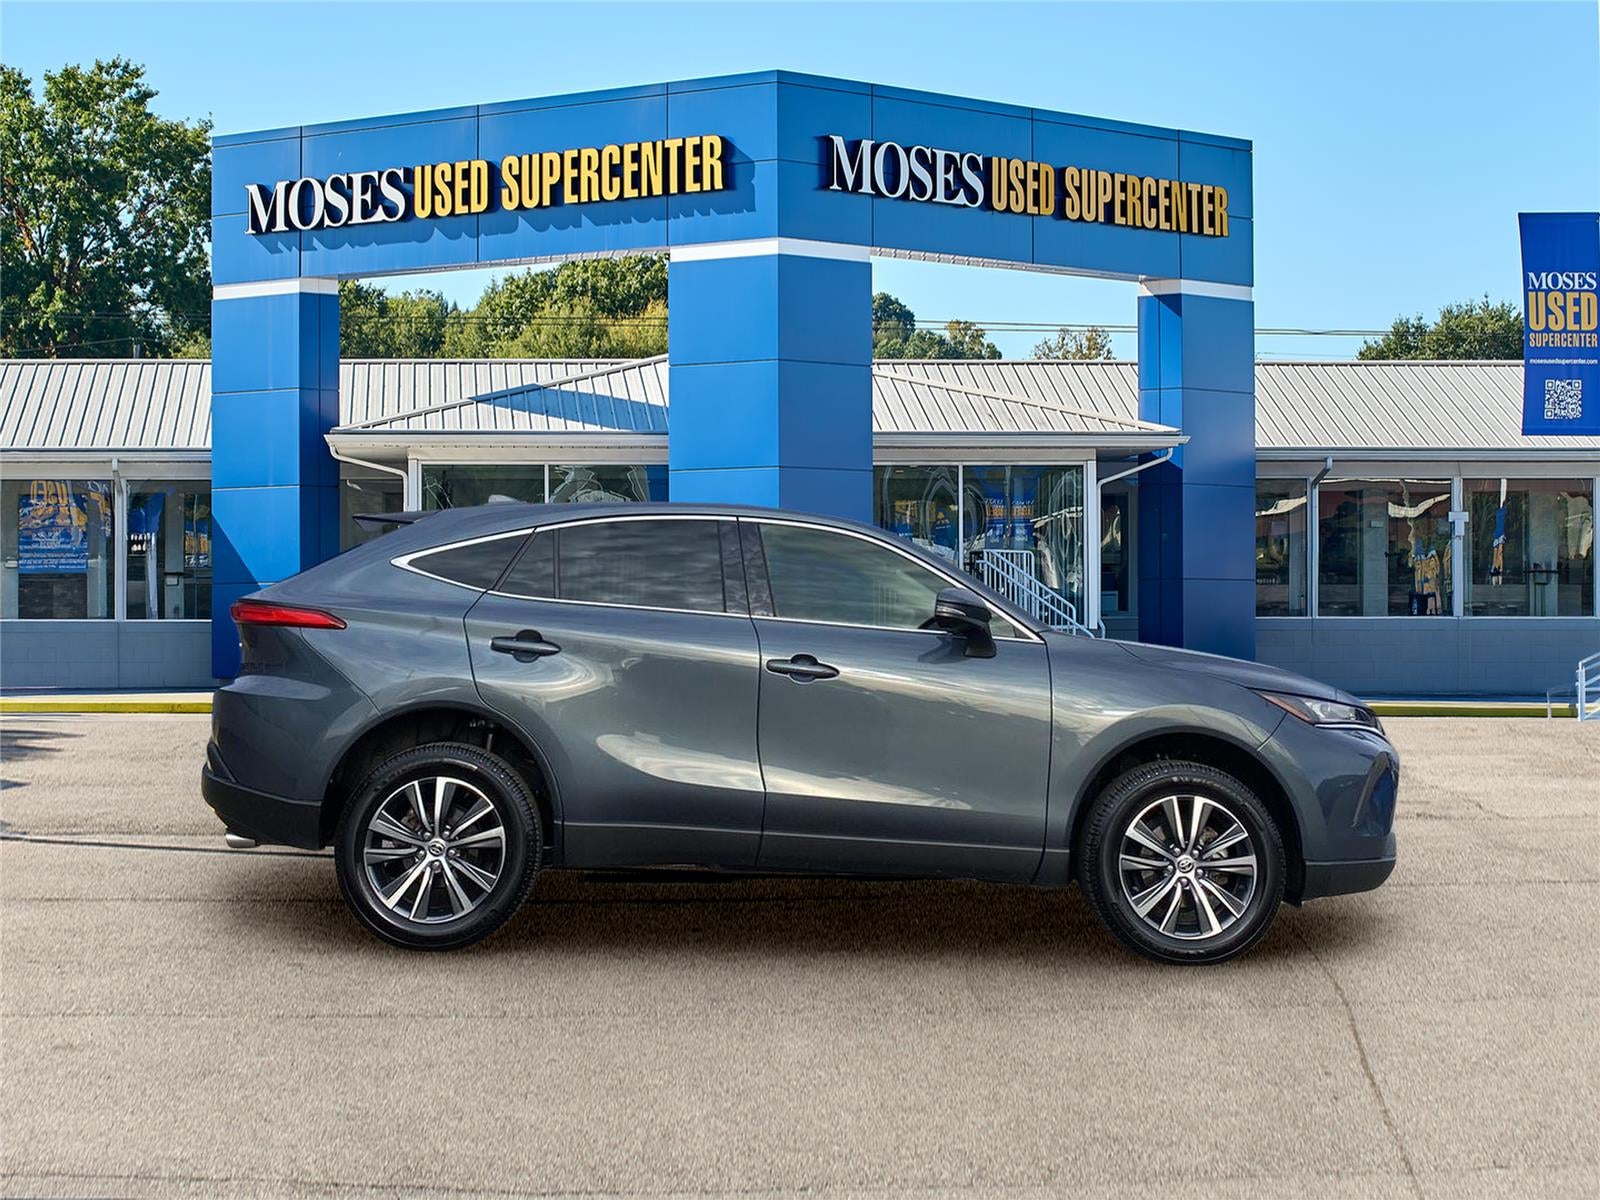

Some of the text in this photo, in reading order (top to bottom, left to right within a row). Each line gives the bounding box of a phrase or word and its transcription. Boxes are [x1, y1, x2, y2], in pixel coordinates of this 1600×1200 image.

[245, 135, 724, 234] MOSES USED SUPERCENTER
[828, 135, 1229, 236] MOSES USED SUPERCENTER
[1528, 271, 1597, 290] MOSES
[1528, 292, 1598, 331] USED
[1529, 333, 1598, 347] SUPERCENTER
